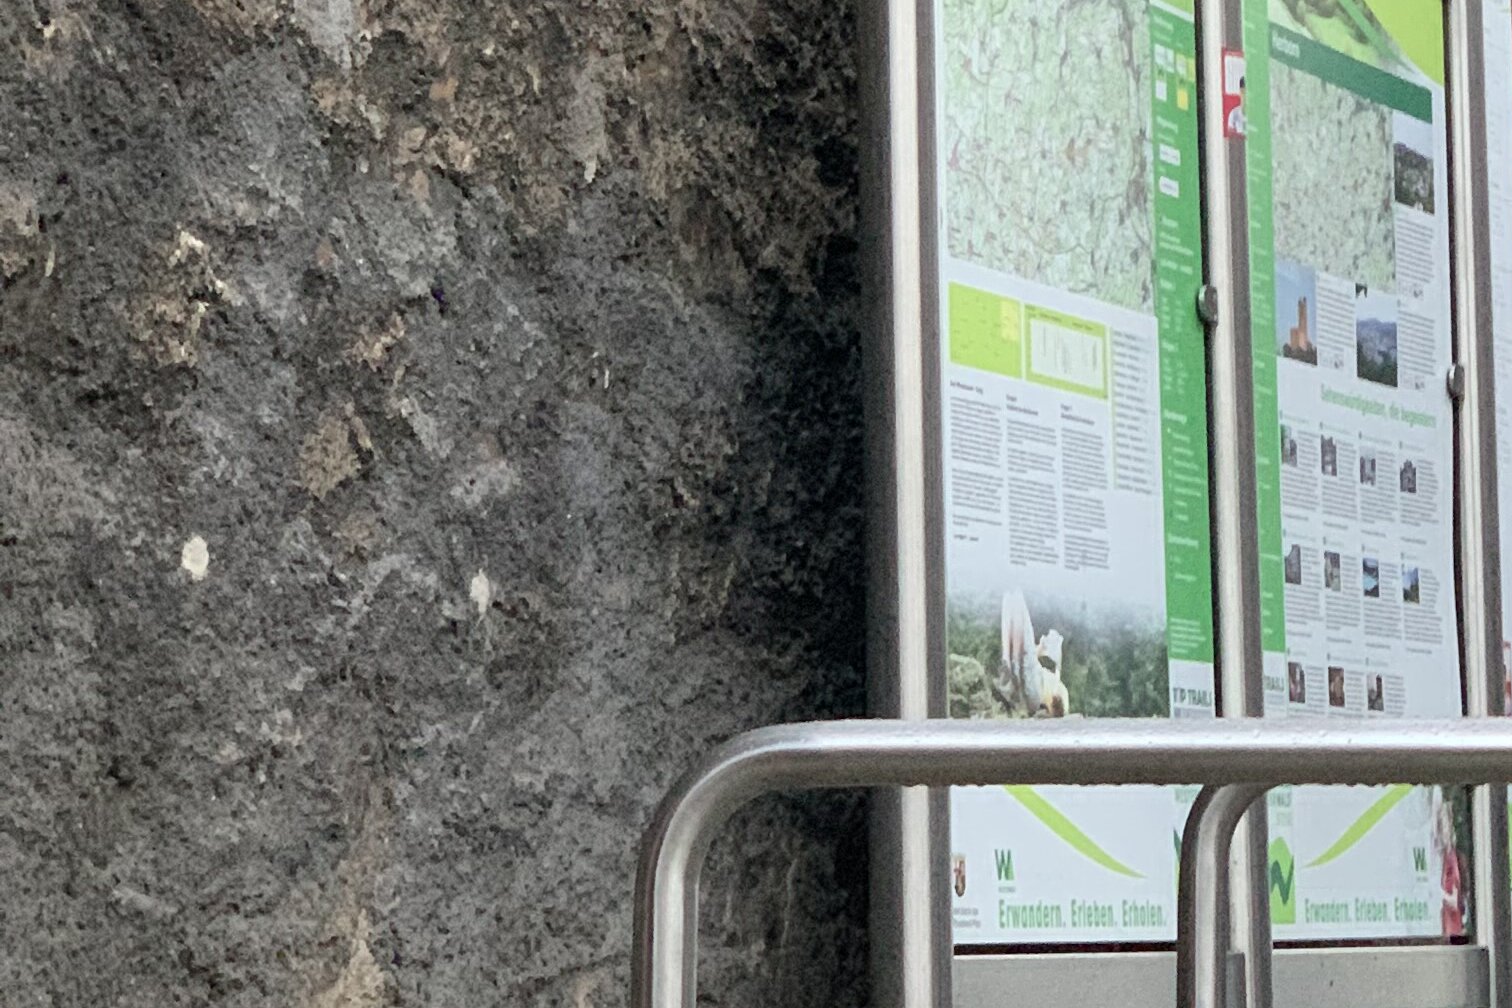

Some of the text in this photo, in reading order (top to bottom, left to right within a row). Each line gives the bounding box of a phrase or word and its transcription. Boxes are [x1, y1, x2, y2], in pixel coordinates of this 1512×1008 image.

[999, 898, 1167, 929] Erwandern. Erleben. Erholen.
